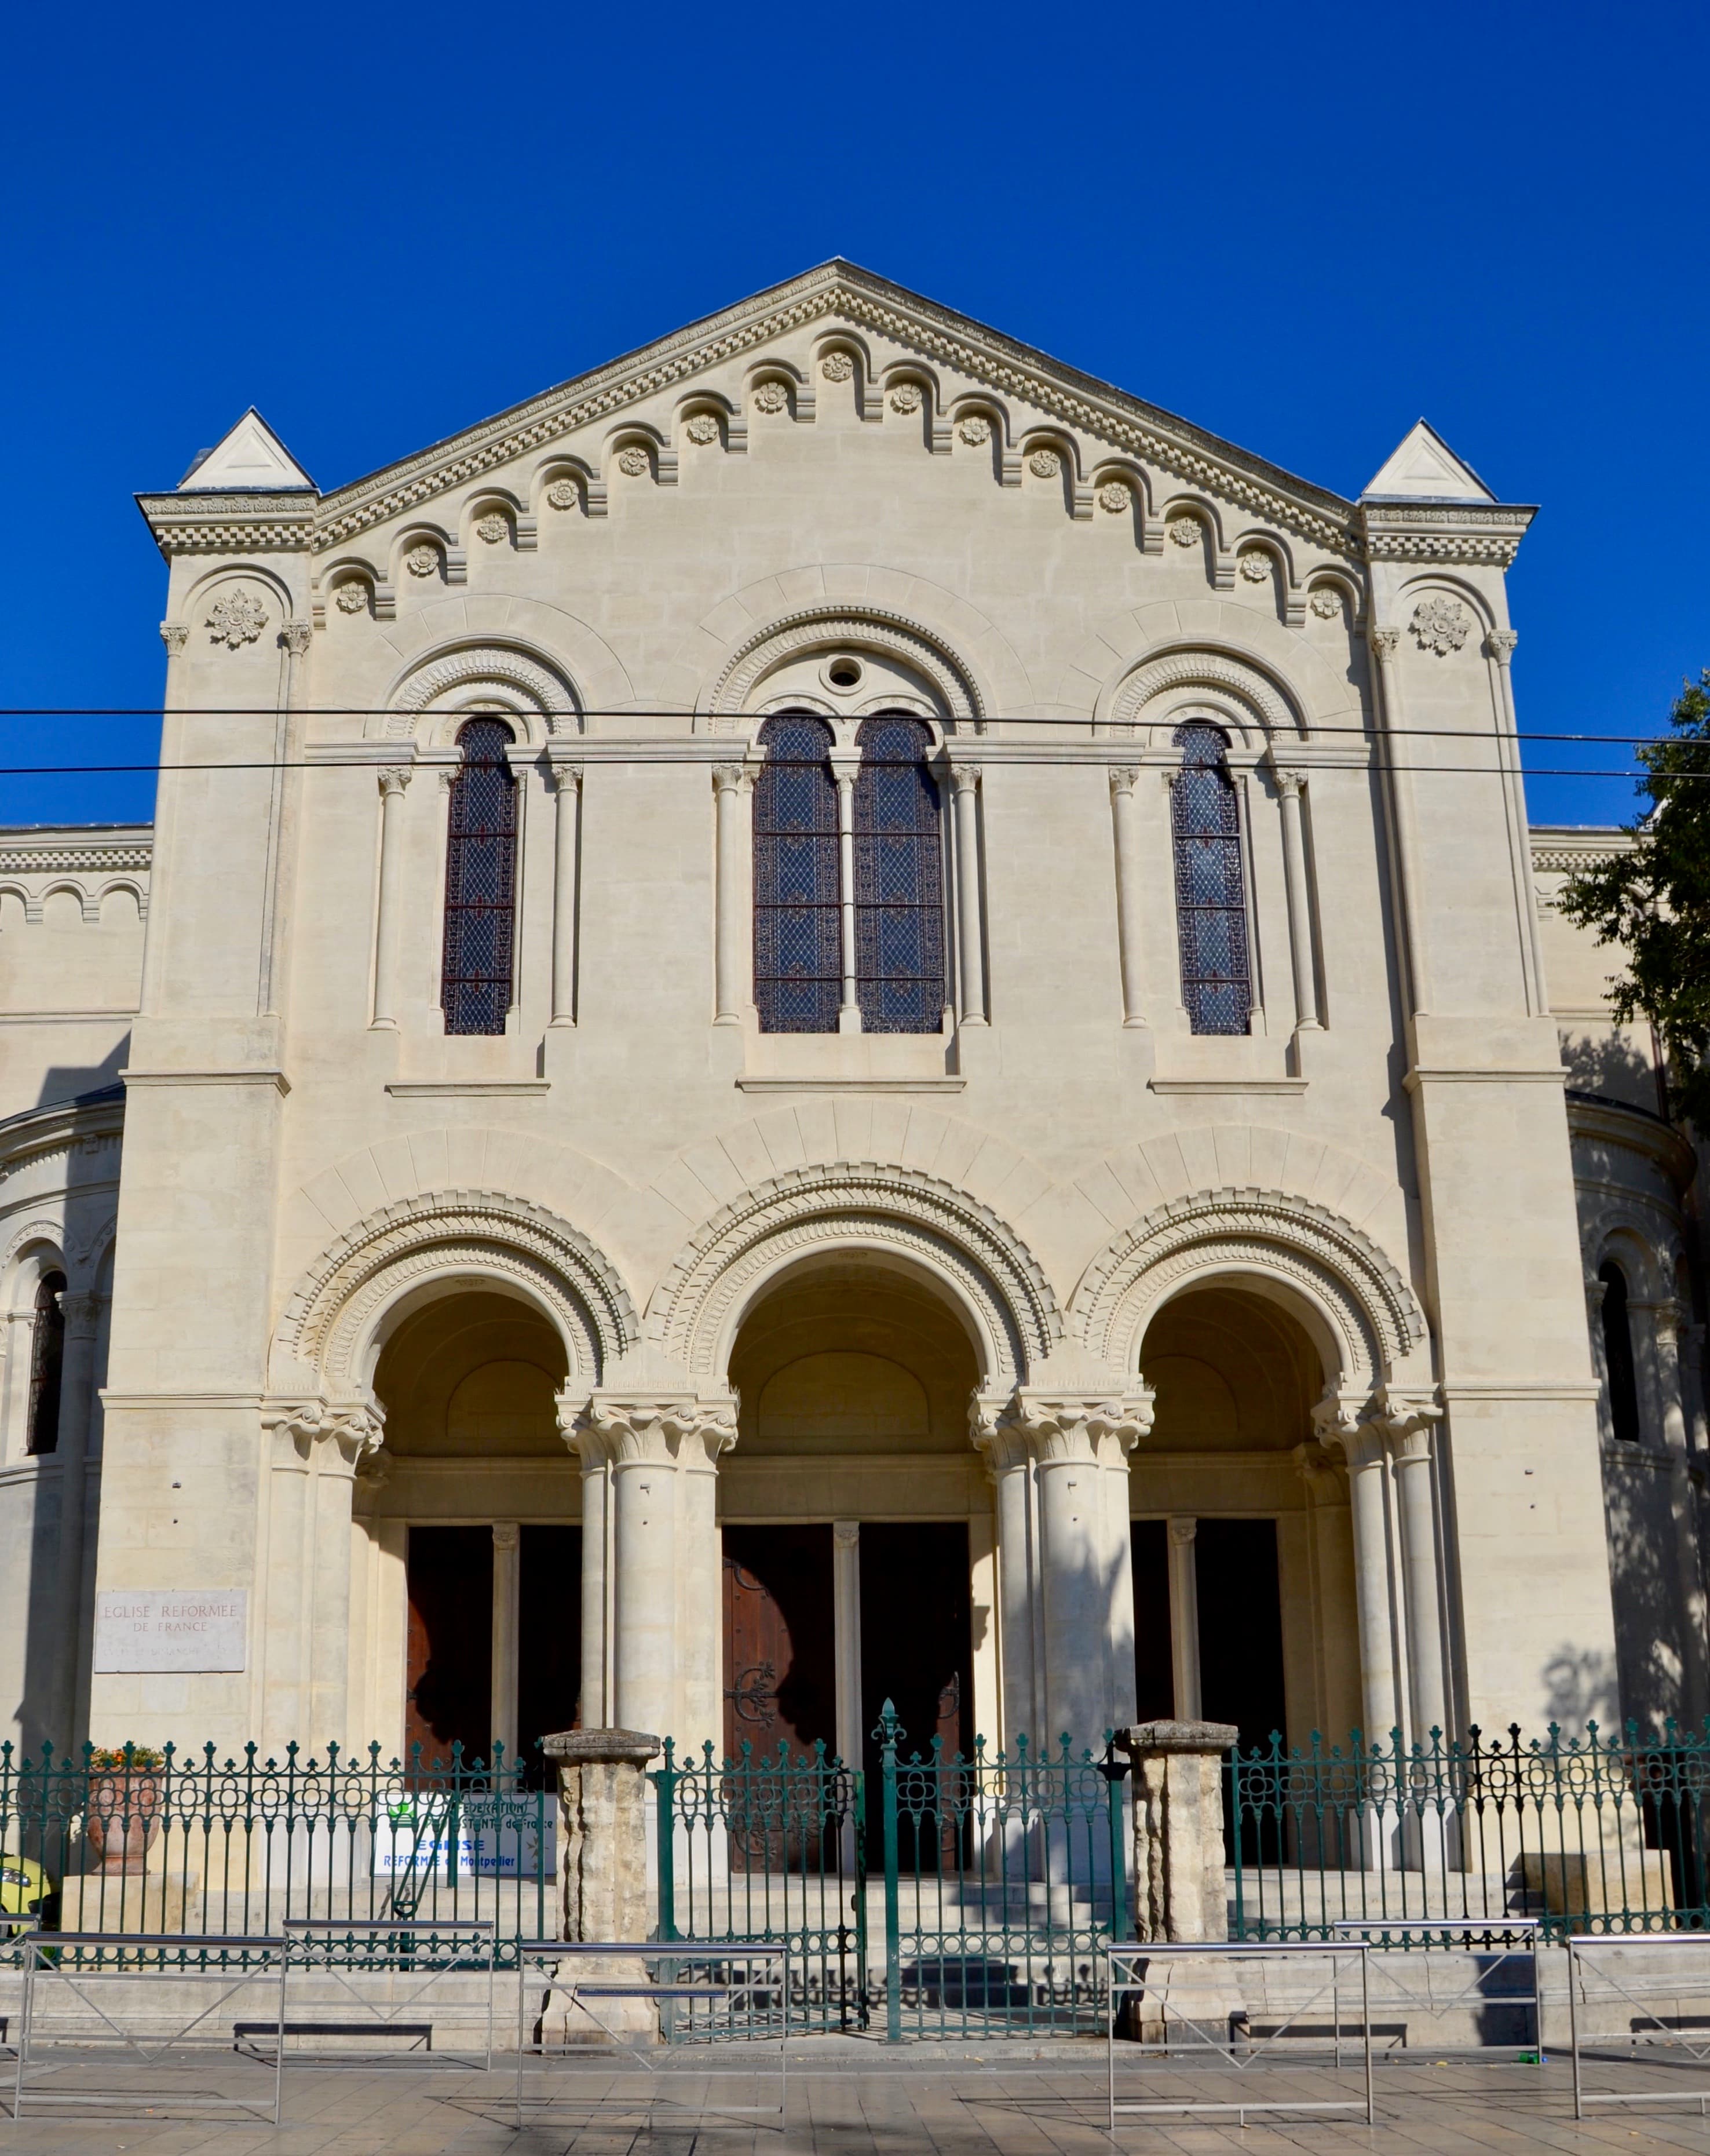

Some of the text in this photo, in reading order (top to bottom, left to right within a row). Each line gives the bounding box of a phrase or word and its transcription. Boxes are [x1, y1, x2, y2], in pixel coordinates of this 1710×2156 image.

[104, 1605, 237, 1618] EGLISE REFORMEE
[134, 1622, 209, 1632] DE FRANCE
